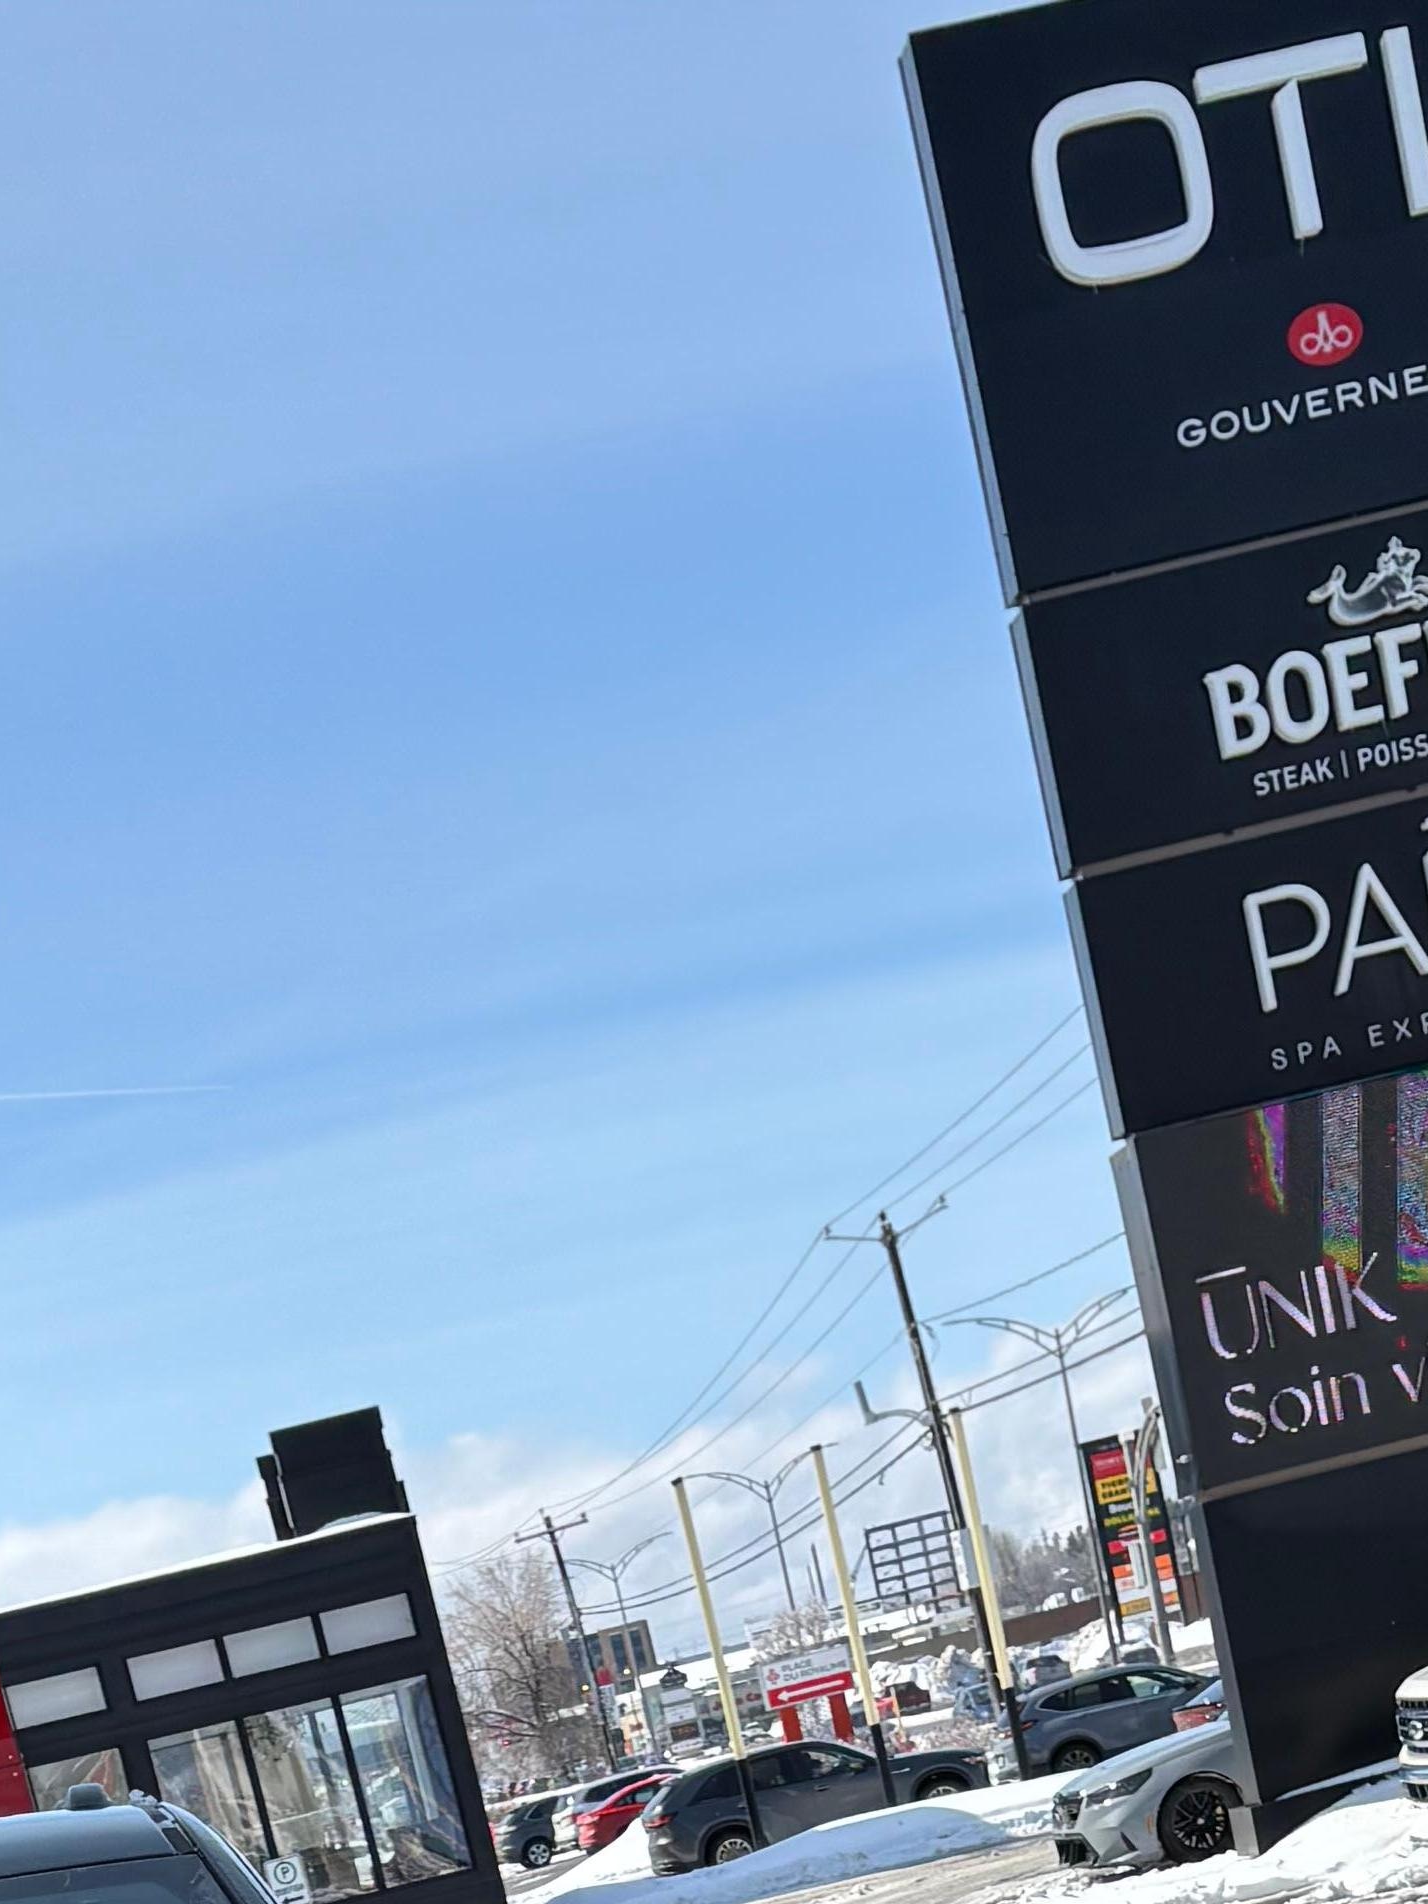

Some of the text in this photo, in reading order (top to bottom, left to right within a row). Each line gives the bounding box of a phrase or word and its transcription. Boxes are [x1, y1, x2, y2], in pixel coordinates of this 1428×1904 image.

[1252, 757, 1335, 798] STEAK
[1270, 1035, 1342, 1071] SPA
[1224, 1364, 1371, 1445] Soin
